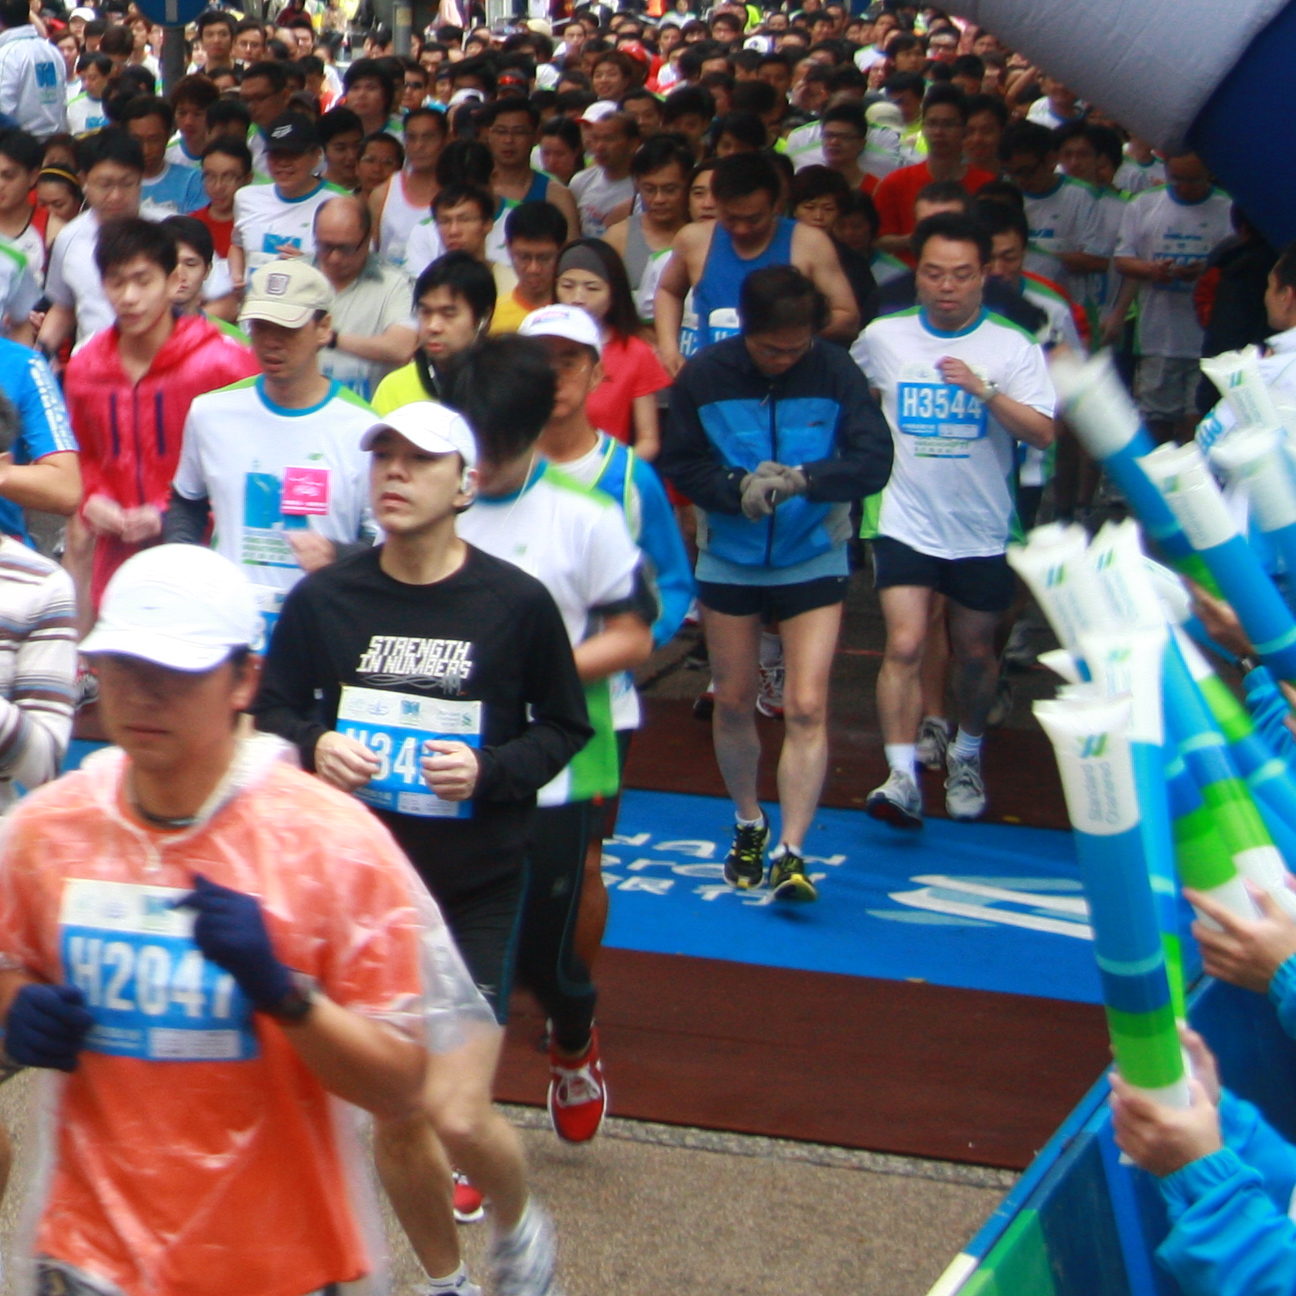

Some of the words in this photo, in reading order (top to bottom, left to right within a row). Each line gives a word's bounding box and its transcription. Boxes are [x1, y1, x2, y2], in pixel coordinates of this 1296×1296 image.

[903, 386, 983, 420] H3544
[367, 635, 473, 661] STRENGTH
[356, 653, 381, 673] IN
[382, 655, 473, 679] NUMBERS
